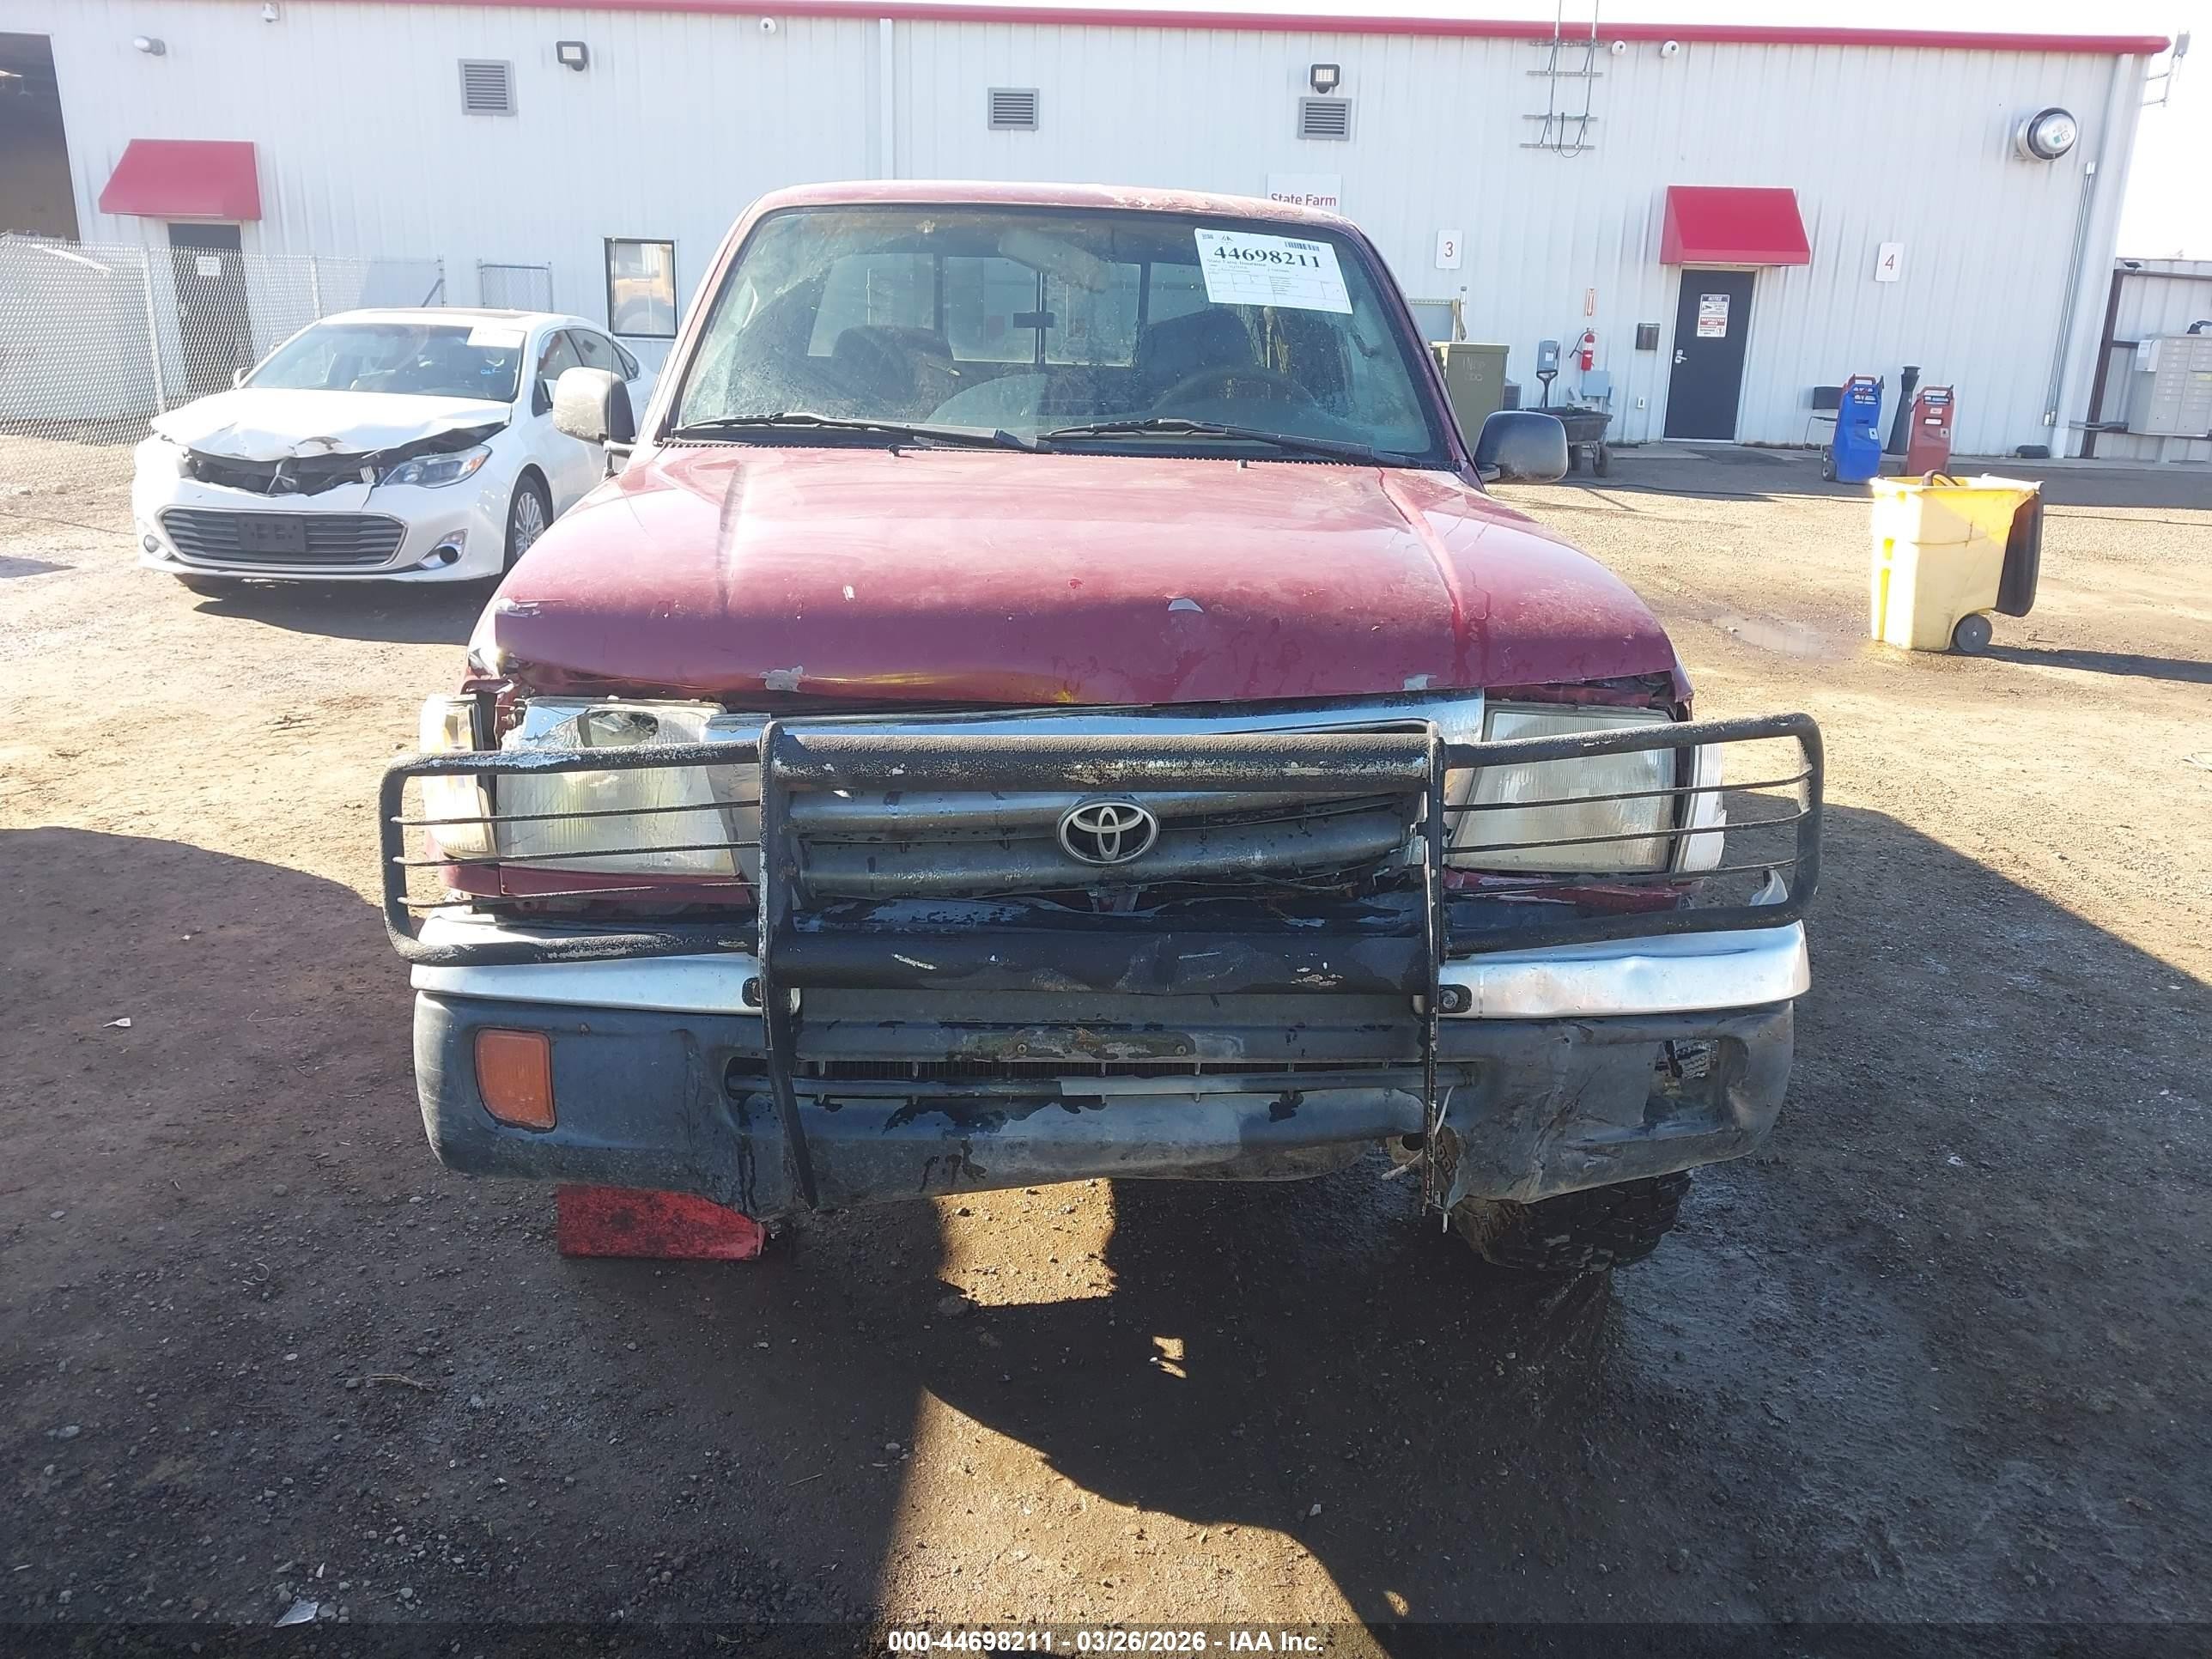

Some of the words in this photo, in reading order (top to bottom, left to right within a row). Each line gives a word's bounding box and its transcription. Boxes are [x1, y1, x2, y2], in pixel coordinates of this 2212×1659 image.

[1271, 192, 1303, 205] State
[1305, 193, 1337, 207] Farm
[1213, 246, 1321, 268] 44698211
[1444, 240, 1454, 258] 3
[1884, 253, 1895, 270] 4
